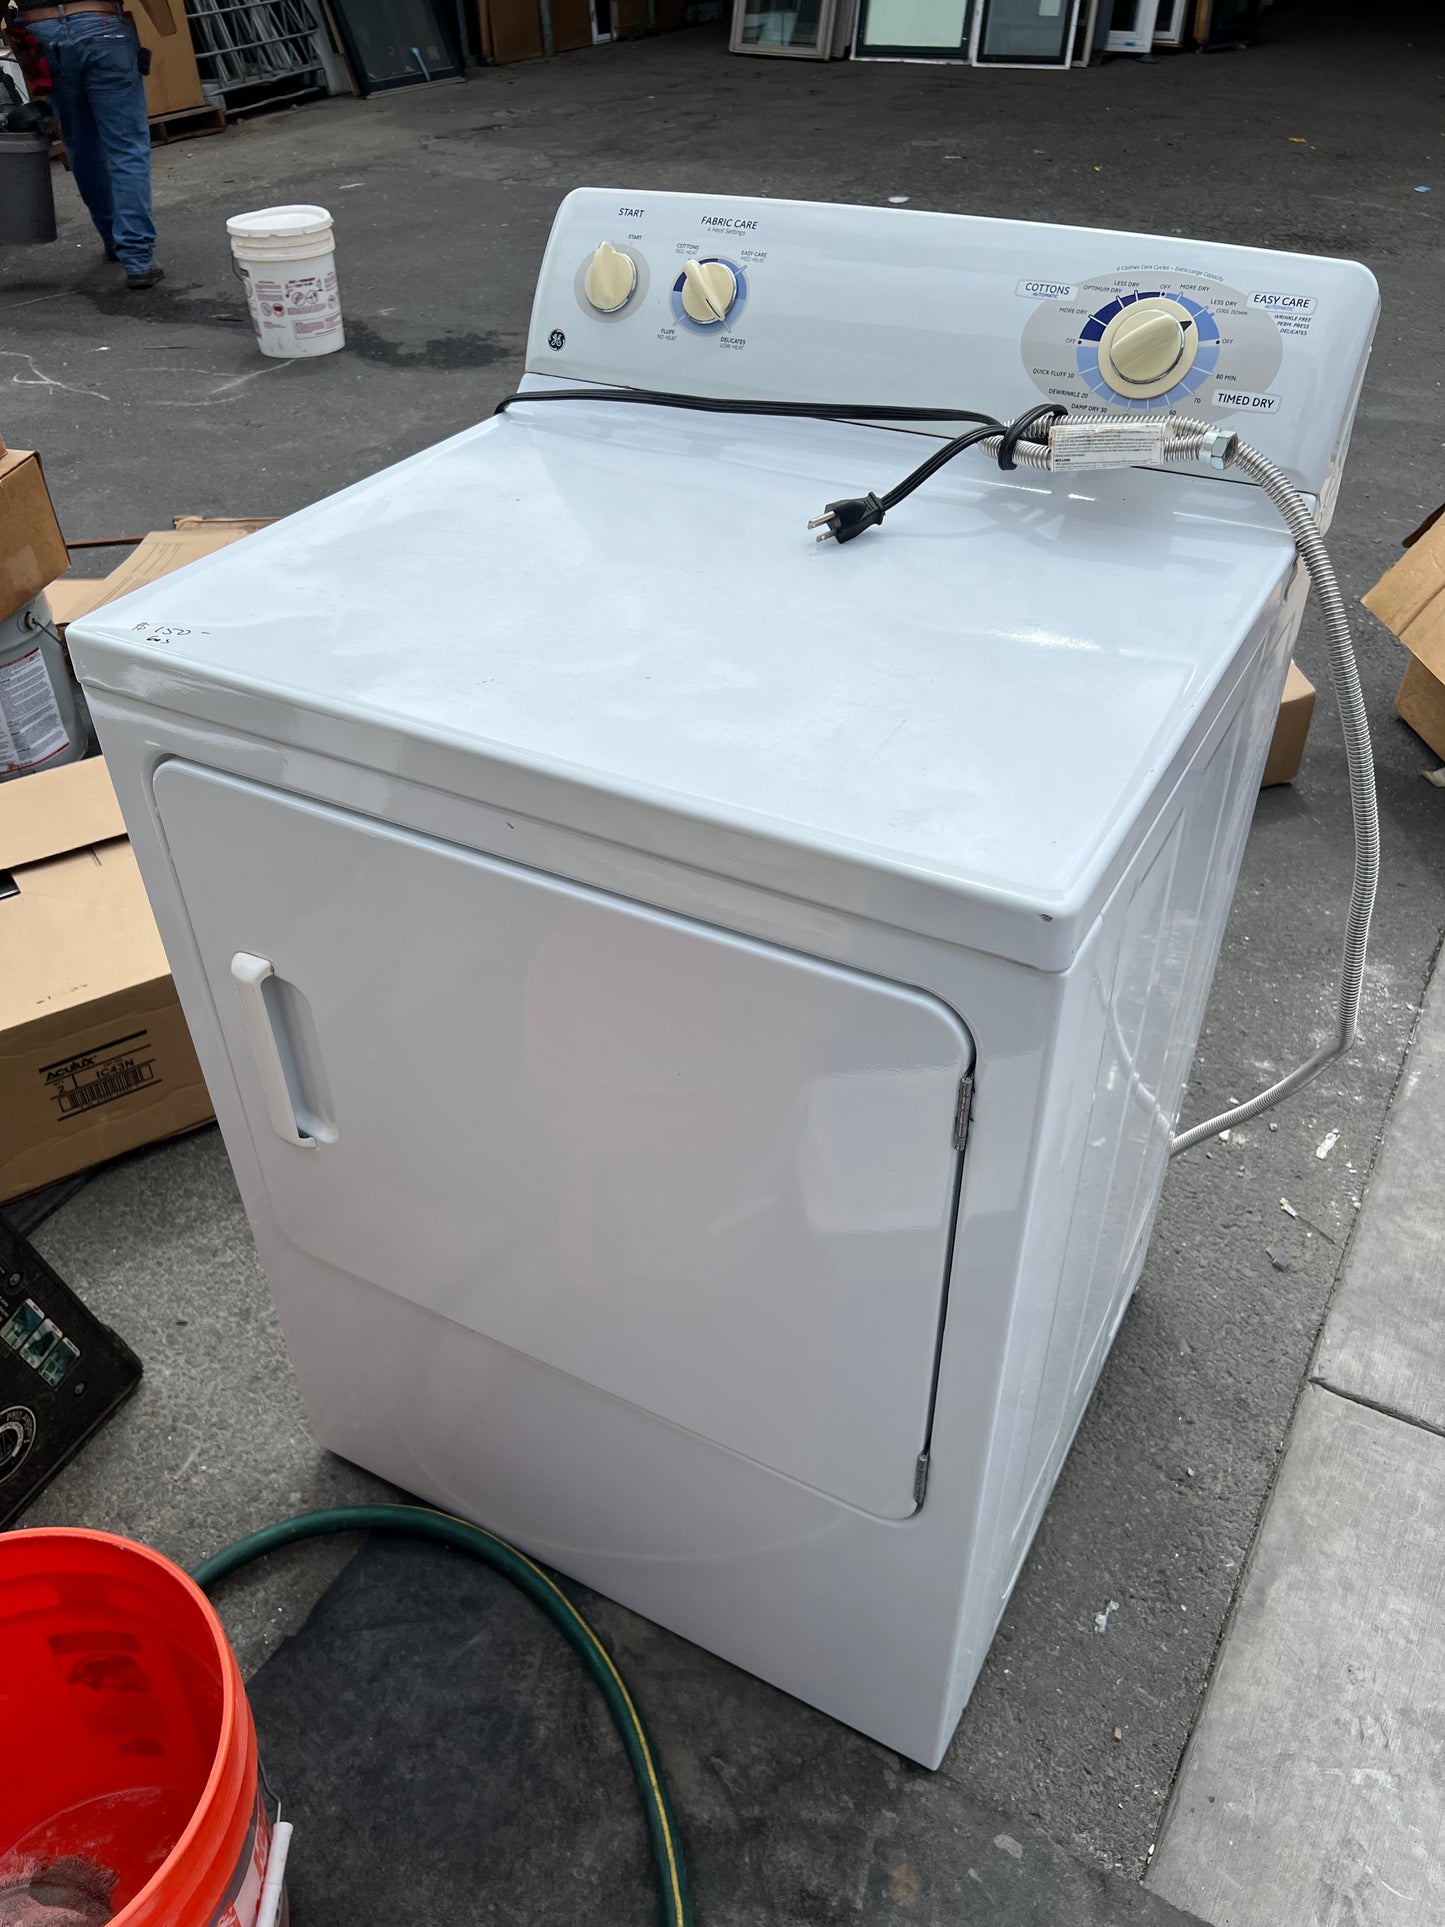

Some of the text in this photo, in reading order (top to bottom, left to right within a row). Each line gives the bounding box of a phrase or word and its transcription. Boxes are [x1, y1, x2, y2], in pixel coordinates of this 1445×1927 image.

[619, 208, 644, 218] START
[701, 216, 758, 230] FABRIC CARE
[725, 228, 746, 236] Settings
[676, 243, 699, 251] COTTONS
[1025, 282, 1070, 296] COTTONS
[1083, 284, 1110, 293] OPTIMUM
[1253, 294, 1311, 309] EASY CARE
[1059, 307, 1075, 315] MORE
[1264, 304, 1294, 312] AUTOMATIC
[1274, 314, 1298, 322] WRINKLE
[1293, 322, 1310, 330] PRESS
[1280, 328, 1307, 336] DELICATES
[720, 336, 746, 345] DELICATES
[1032, 368, 1050, 376] QUICK
[1048, 388, 1080, 398] DEWRINKLE
[1218, 393, 1274, 409] TIMED DRY
[47, 1057, 95, 1081] Aculux
